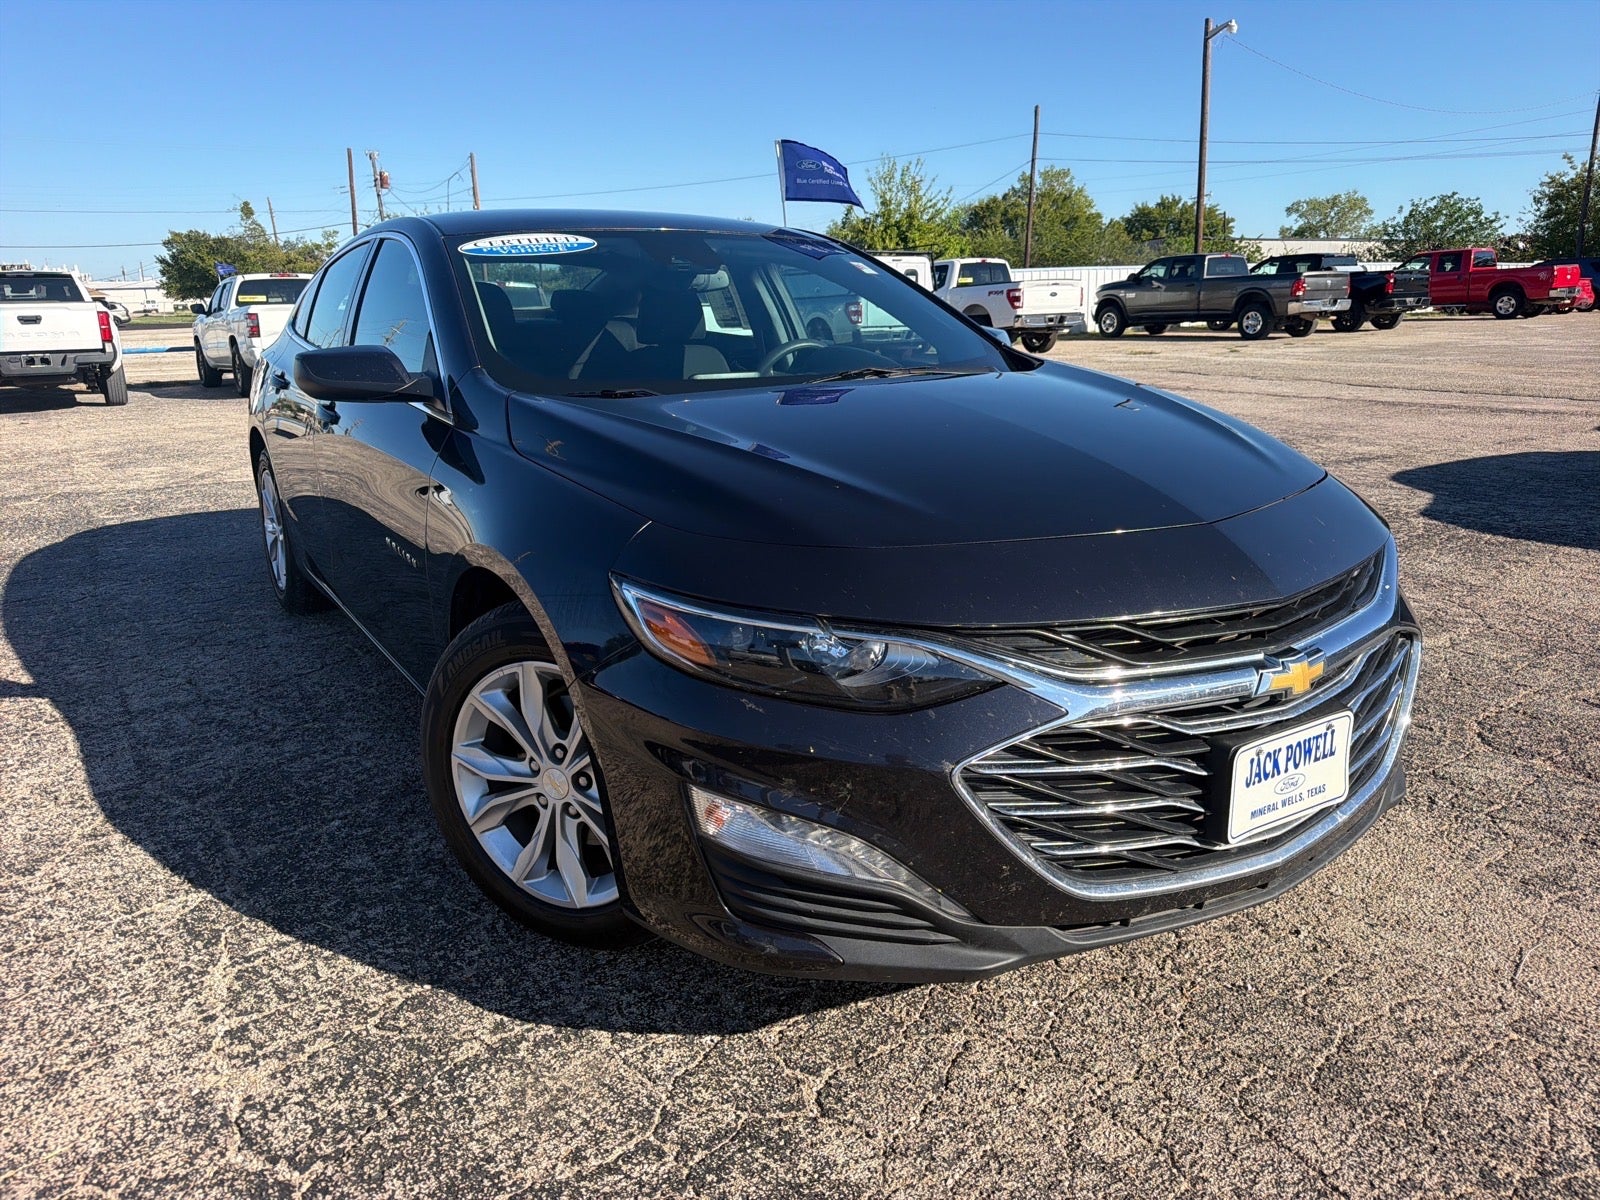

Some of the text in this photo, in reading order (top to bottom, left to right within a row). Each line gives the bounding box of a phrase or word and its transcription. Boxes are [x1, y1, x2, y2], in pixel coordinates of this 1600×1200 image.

[473, 236, 579, 247] CERTIFIED
[500, 245, 568, 254] VEHICLE
[385, 536, 417, 568] MALIBU
[1245, 729, 1336, 788] JACK POWELL
[1279, 776, 1299, 792] Ford
[1250, 783, 1327, 820] MINERAL WELLS, TEXAS
